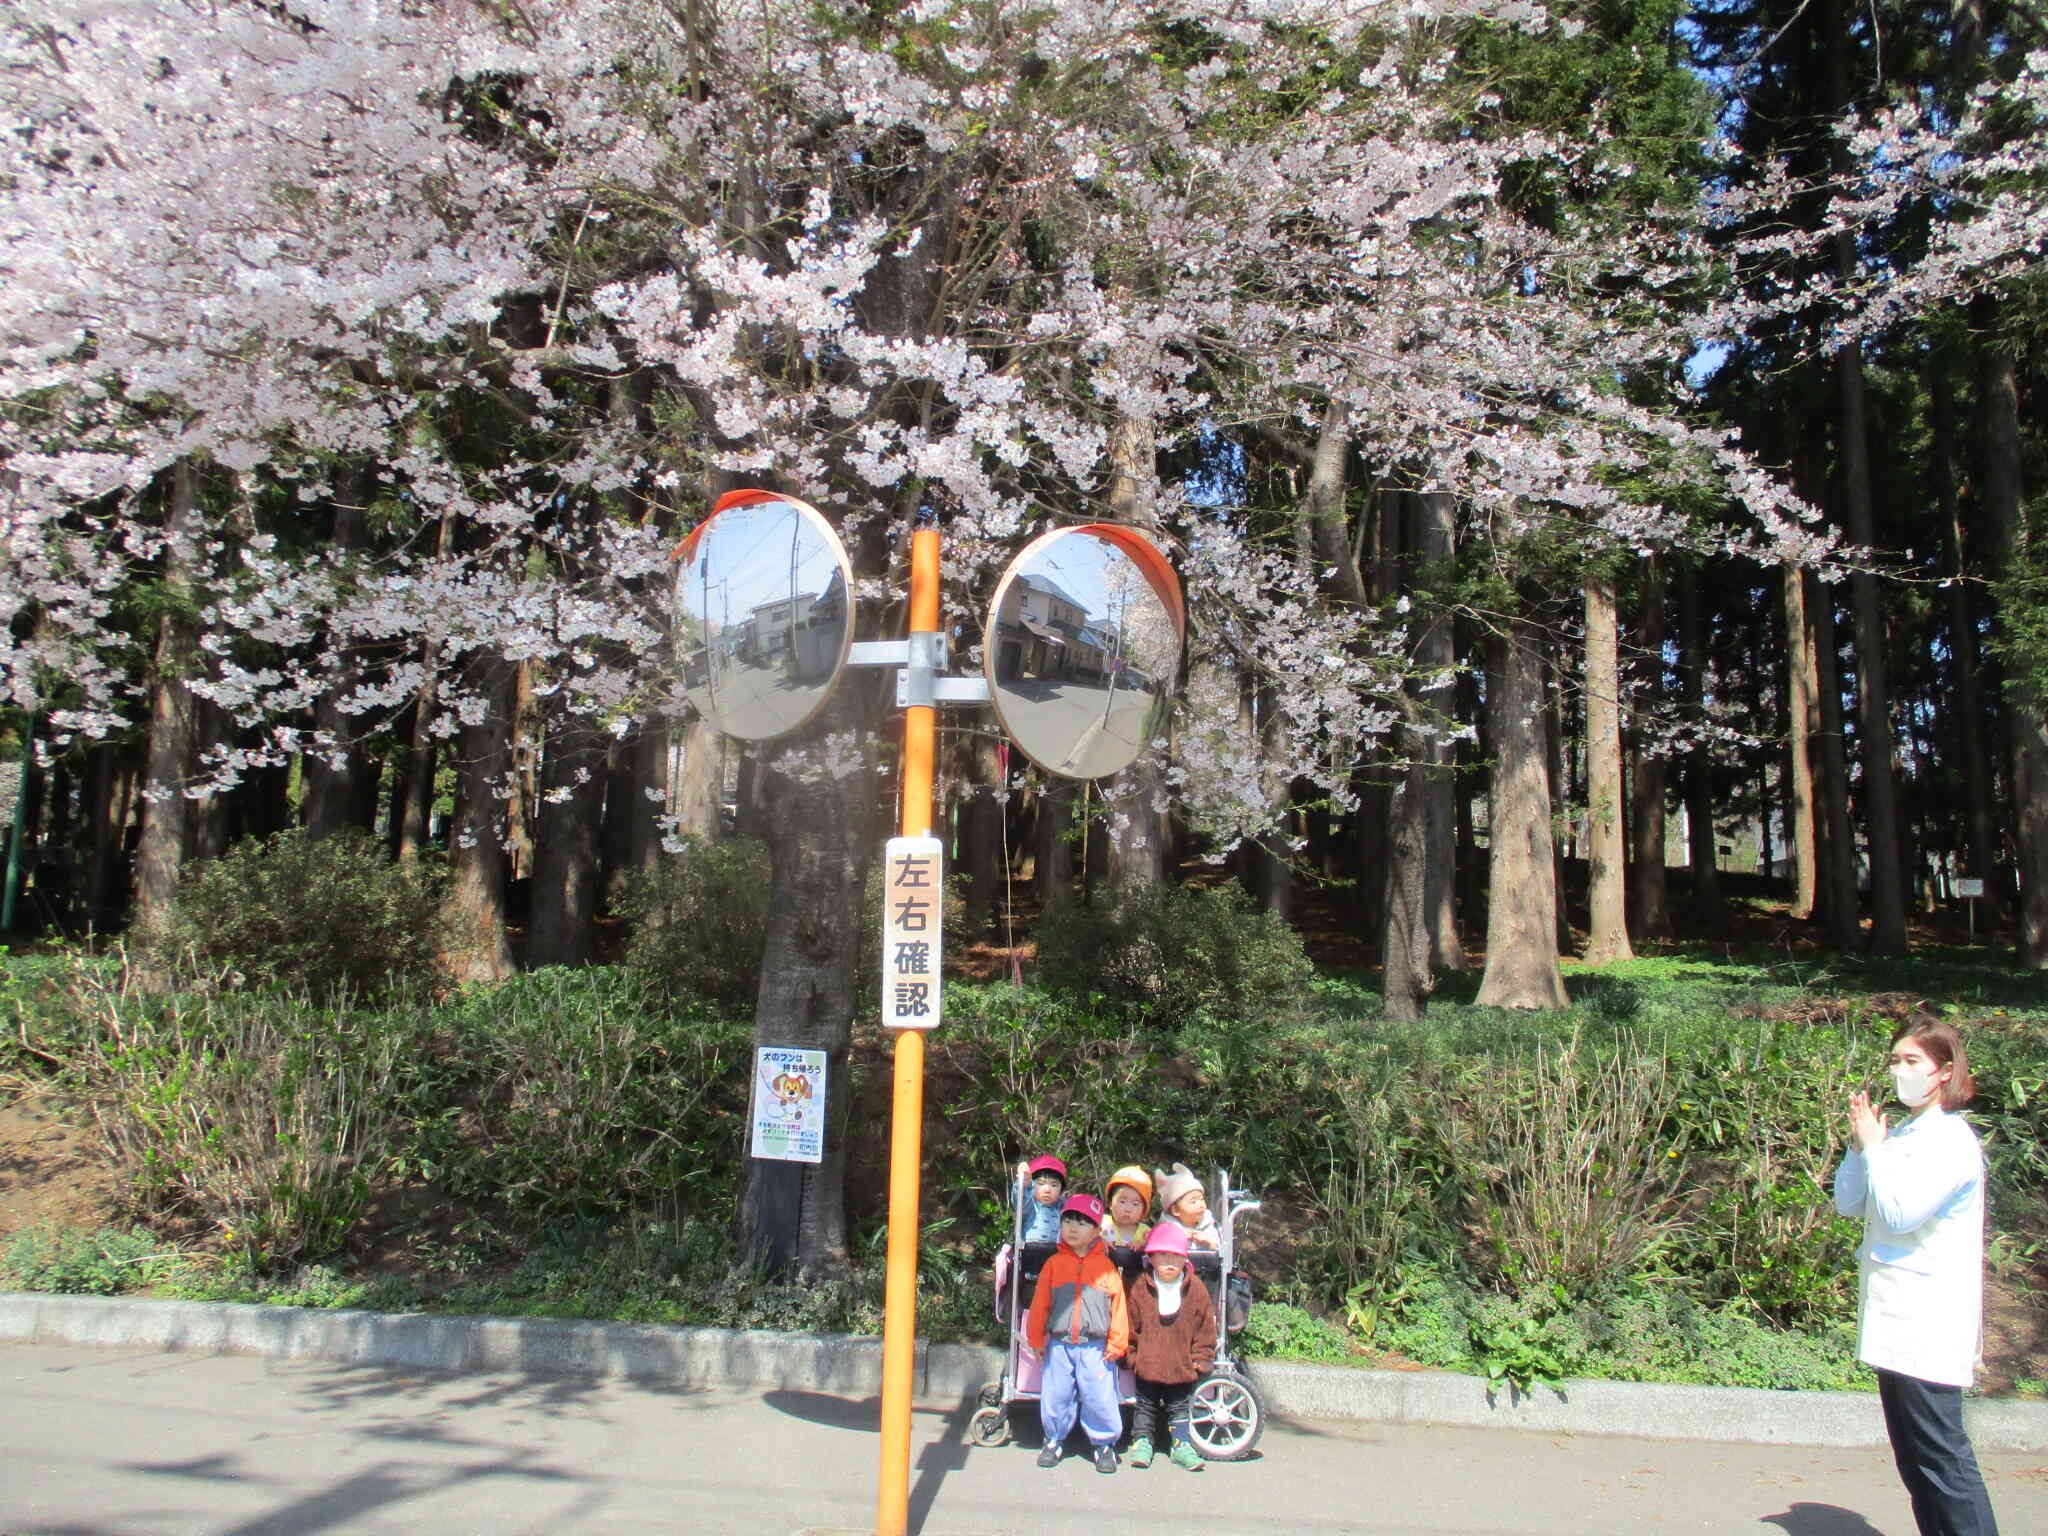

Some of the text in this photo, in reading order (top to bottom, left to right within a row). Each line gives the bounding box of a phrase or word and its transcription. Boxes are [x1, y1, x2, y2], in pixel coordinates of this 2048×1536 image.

[894, 853, 930, 1017] 左右確認
[763, 1052, 803, 1062] 犬のフンは
[783, 1064, 821, 1074] 持ち帰ろう
